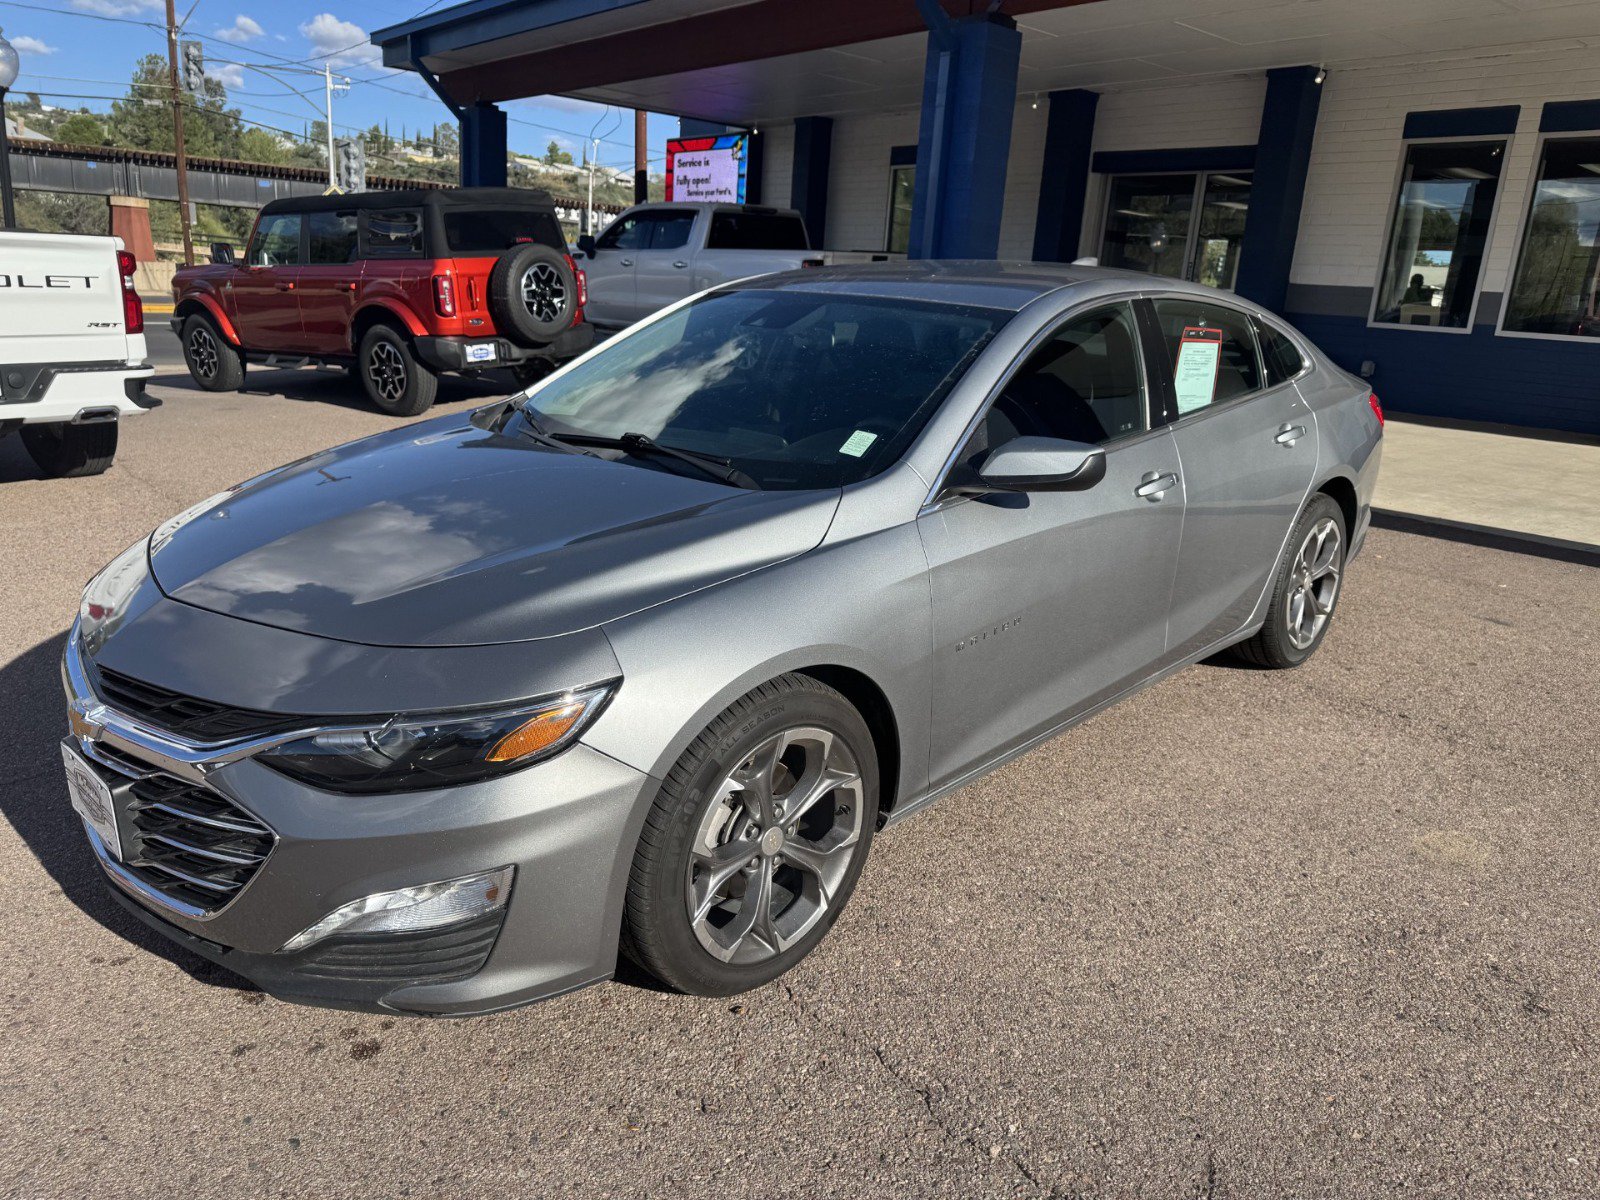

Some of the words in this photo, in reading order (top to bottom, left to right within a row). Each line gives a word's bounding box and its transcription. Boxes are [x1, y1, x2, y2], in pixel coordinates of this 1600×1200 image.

[677, 157, 702, 168] Service
[703, 157, 710, 167] is
[676, 174, 691, 189] fully
[692, 173, 712, 188] open!
[955, 615, 1022, 653] MALIBU
[721, 736, 741, 757] ALL
[742, 705, 785, 735] SEASON
